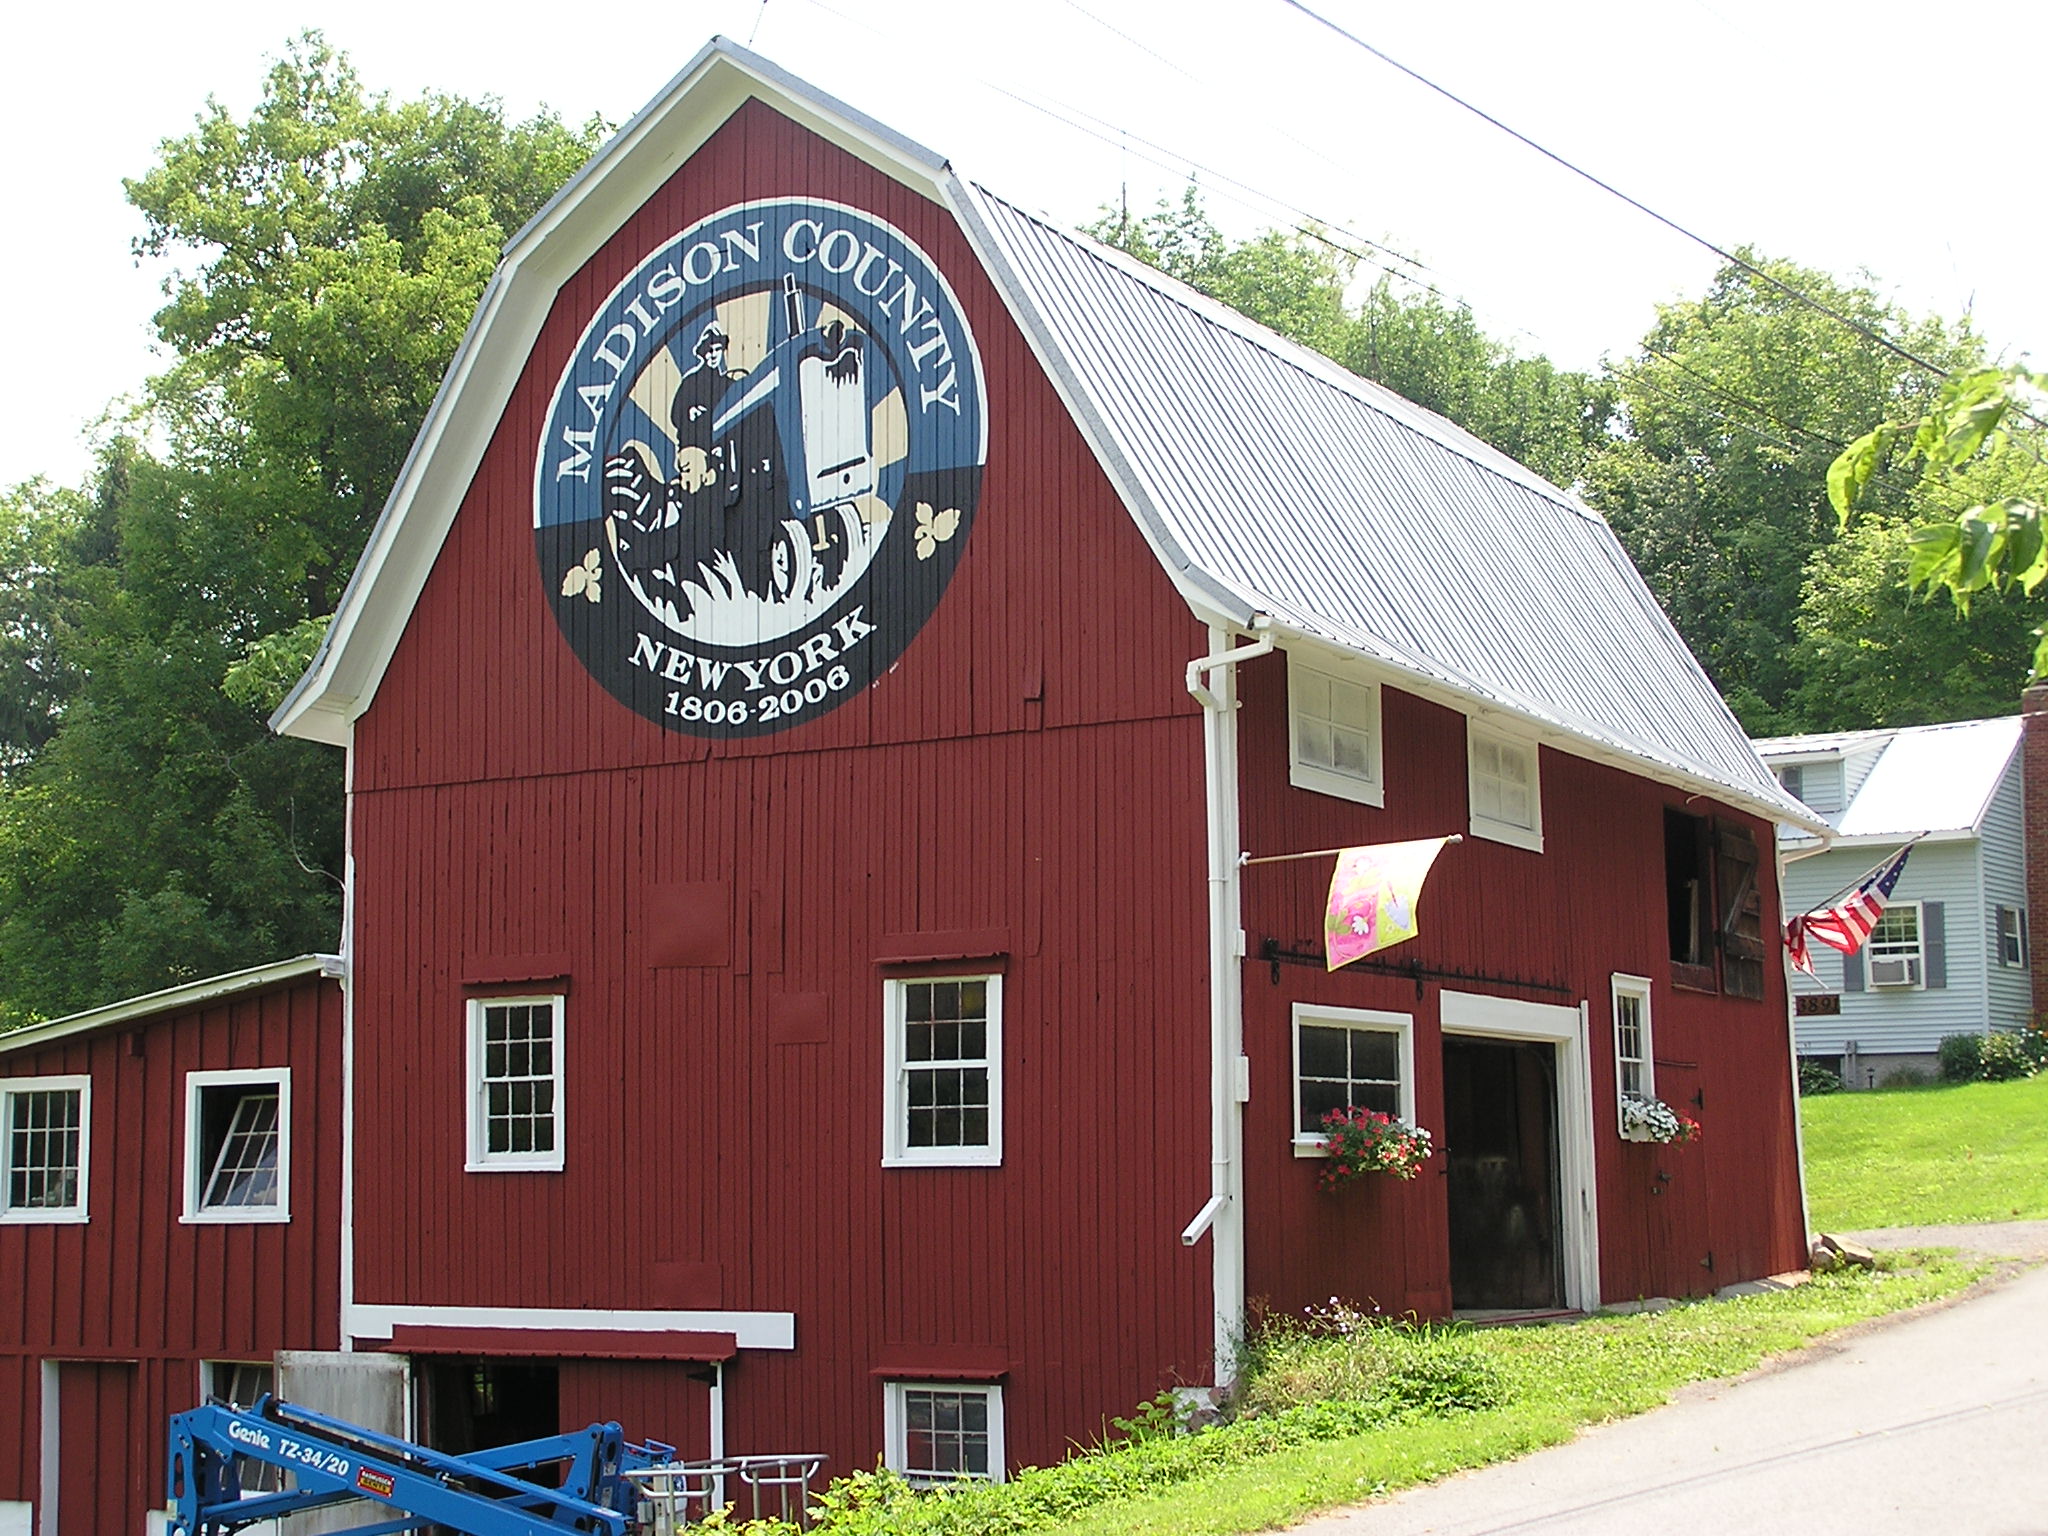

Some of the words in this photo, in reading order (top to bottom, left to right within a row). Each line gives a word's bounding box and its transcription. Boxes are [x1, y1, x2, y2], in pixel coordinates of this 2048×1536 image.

[556, 221, 765, 484] MADISON
[782, 219, 961, 417] COUNTY
[628, 632, 732, 691] NEW
[733, 605, 877, 692] YORK
[664, 665, 850, 725] 1806-2006
[228, 1420, 271, 1450] Genie
[278, 1438, 350, 1477] TZ-34/20
